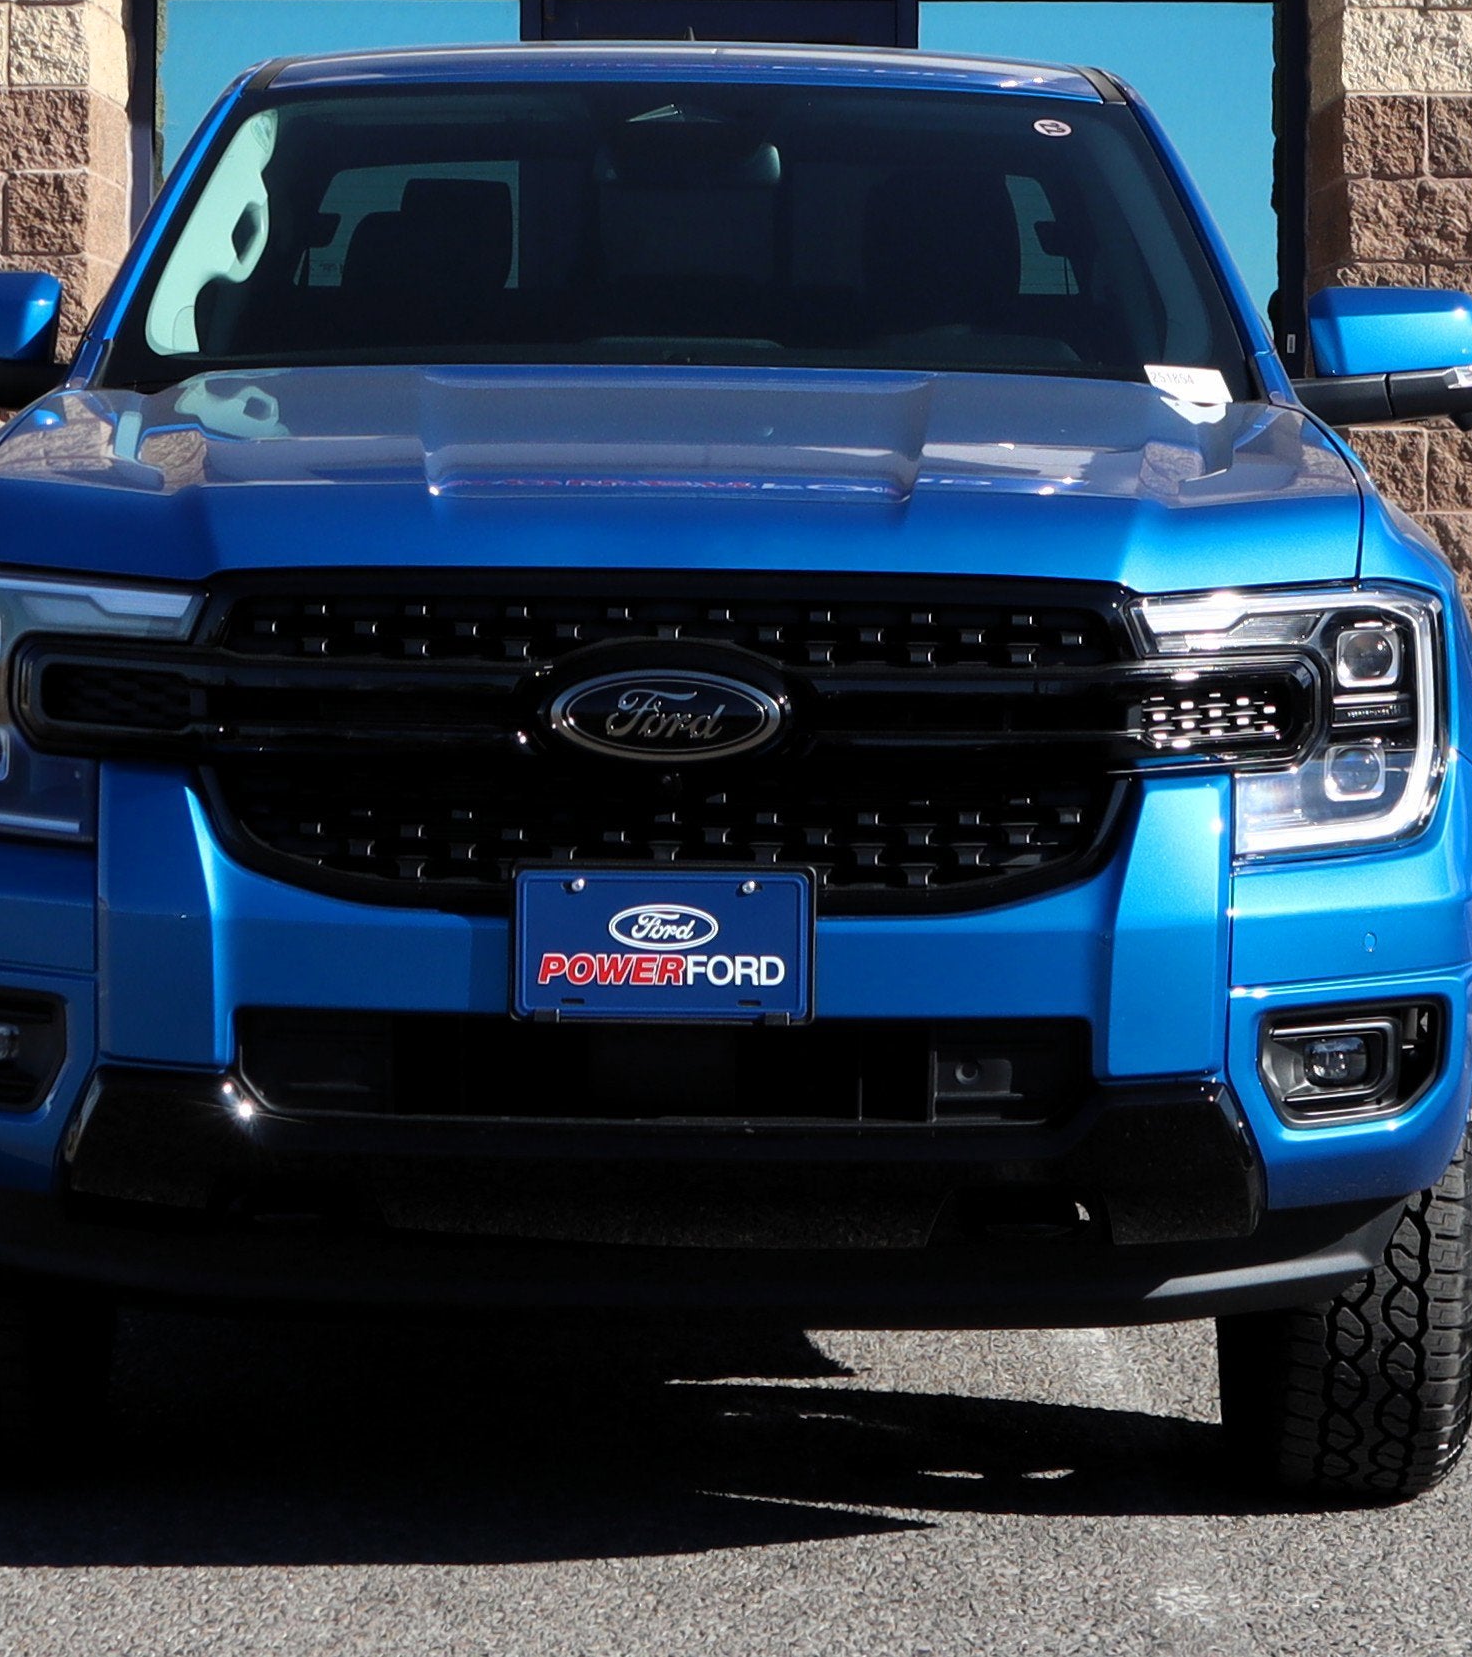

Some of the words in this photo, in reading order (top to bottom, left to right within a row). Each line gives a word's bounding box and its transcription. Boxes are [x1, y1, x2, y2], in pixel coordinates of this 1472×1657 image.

[605, 688, 725, 740] Ford
[631, 912, 695, 941] Ford
[537, 953, 785, 987] POWERFORD
